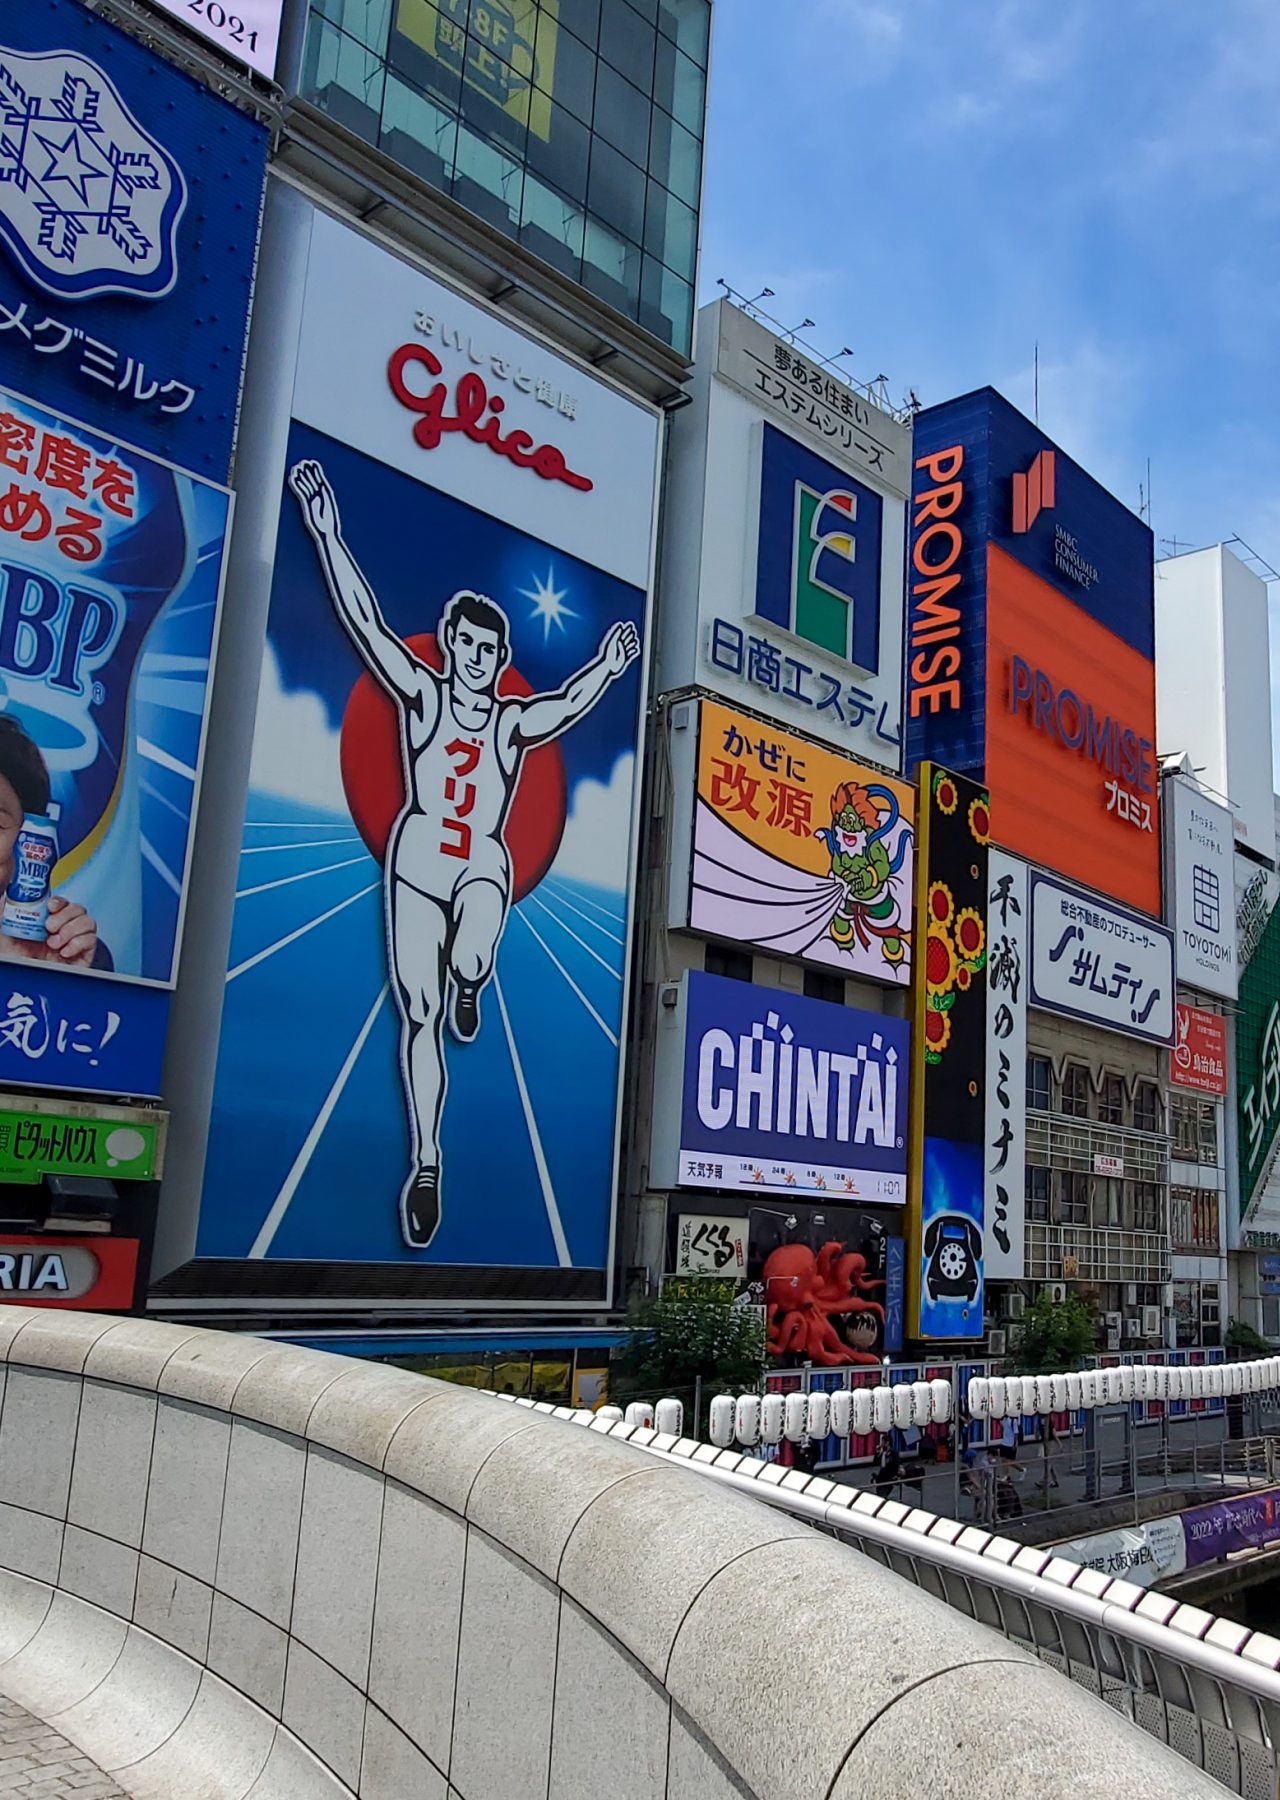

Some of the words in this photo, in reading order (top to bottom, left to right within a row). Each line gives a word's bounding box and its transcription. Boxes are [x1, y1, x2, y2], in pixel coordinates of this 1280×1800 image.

[0, 302, 195, 414] メグミルク
[414, 308, 578, 422] おいしさと健康
[774, 344, 870, 427] 夢ある住まい
[387, 342, 594, 492] Glico
[755, 368, 884, 473] エステムシリーズ
[1055, 523, 1078, 552] SMBC
[1055, 538, 1099, 584] CONSUMER
[1055, 552, 1090, 591] FINANCE
[910, 444, 964, 718] PROMISE
[711, 618, 901, 746] 日商エステム
[723, 725, 806, 783] かぜに
[1011, 654, 1153, 795] PROMISE
[439, 737, 485, 861] グリコ
[710, 757, 814, 838] 改源
[1104, 780, 1153, 833] プロミス
[20, 860, 49, 878] MBP
[1060, 898, 1157, 949] 総合不動産のプロデューサー
[1068, 948, 1143, 1005] サムティ
[697, 1010, 899, 1149] CHINTAI
[13, 1120, 97, 1165] ピタットハウス
[687, 1161, 723, 1180] 天気予報
[691, 1223, 735, 1268] くくる
